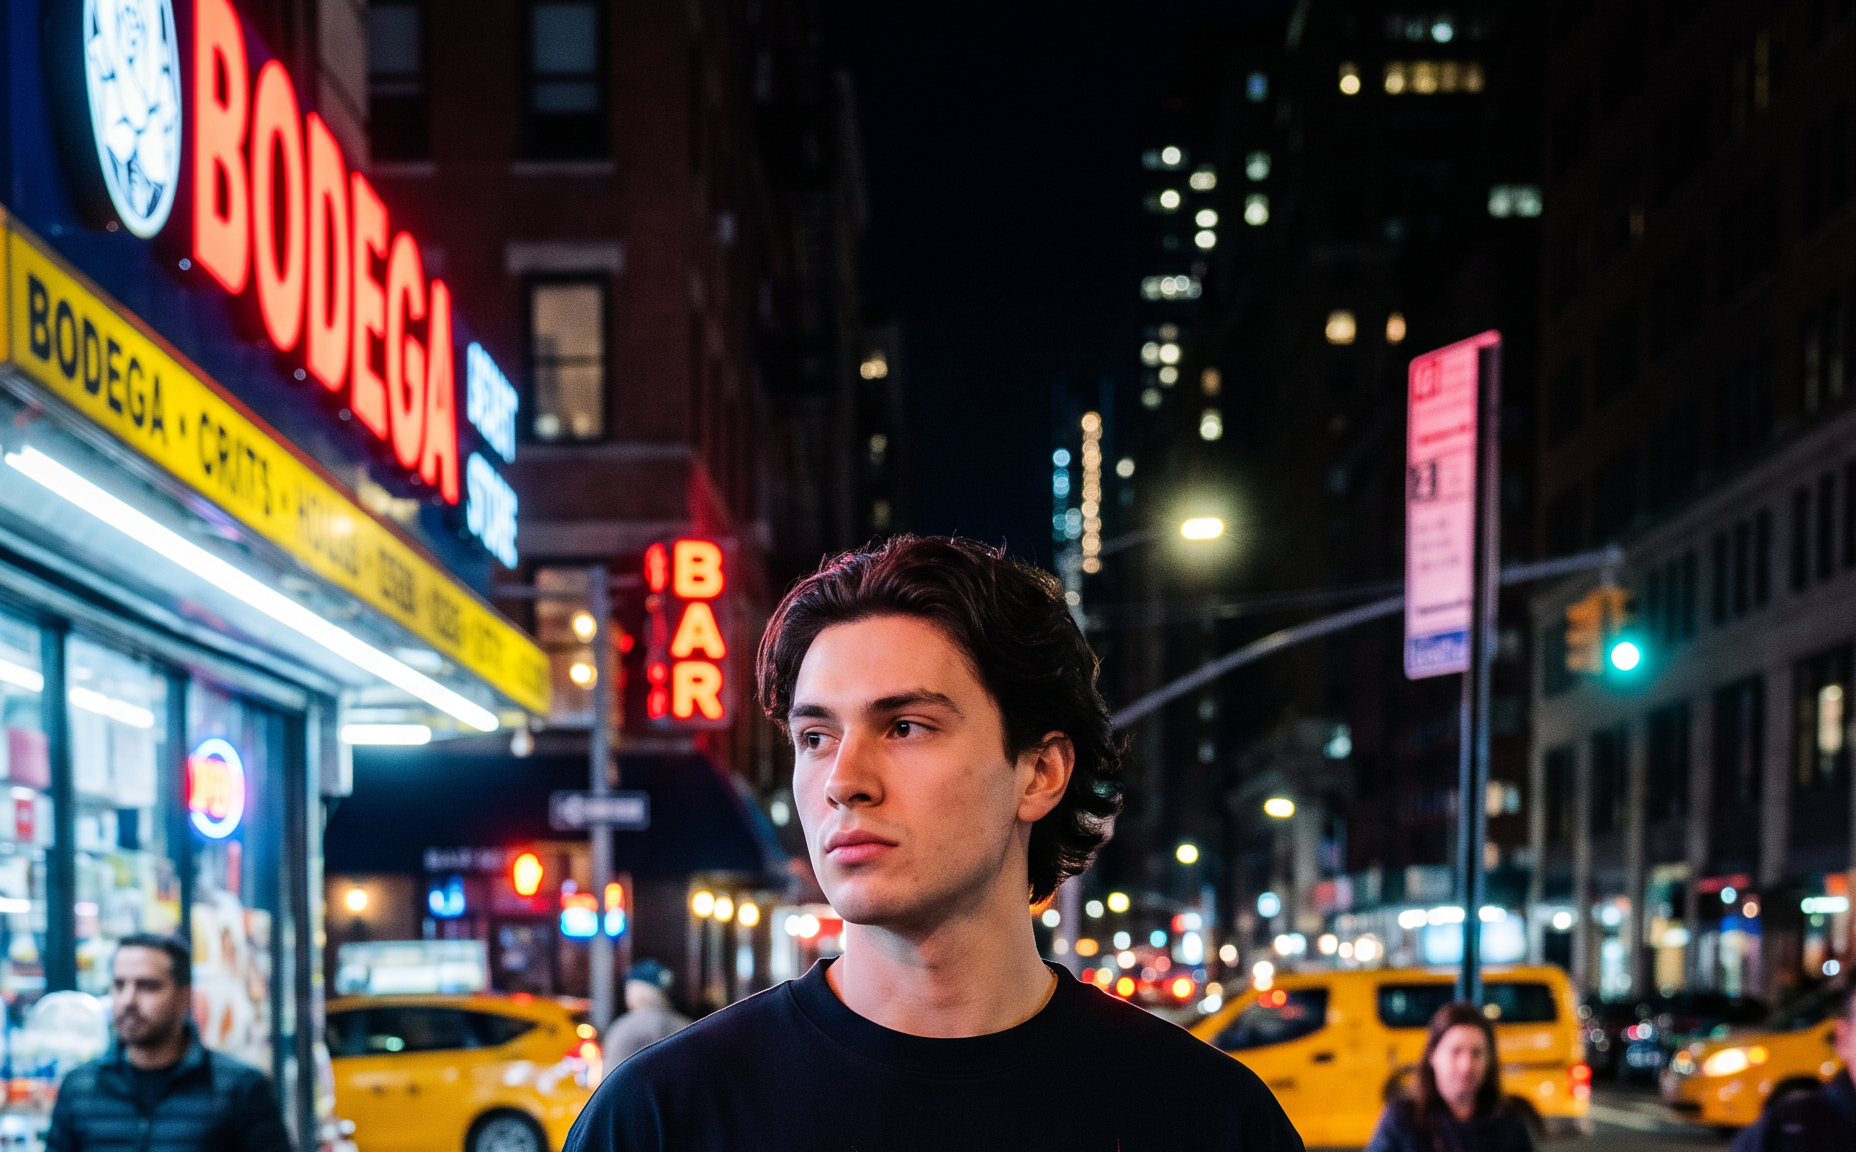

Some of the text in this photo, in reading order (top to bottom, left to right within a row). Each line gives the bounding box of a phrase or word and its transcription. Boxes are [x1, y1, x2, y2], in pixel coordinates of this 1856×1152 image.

[192, 0, 461, 506] BODEGA
[28, 272, 169, 447] BODEGA
[669, 537, 728, 721] BAR
